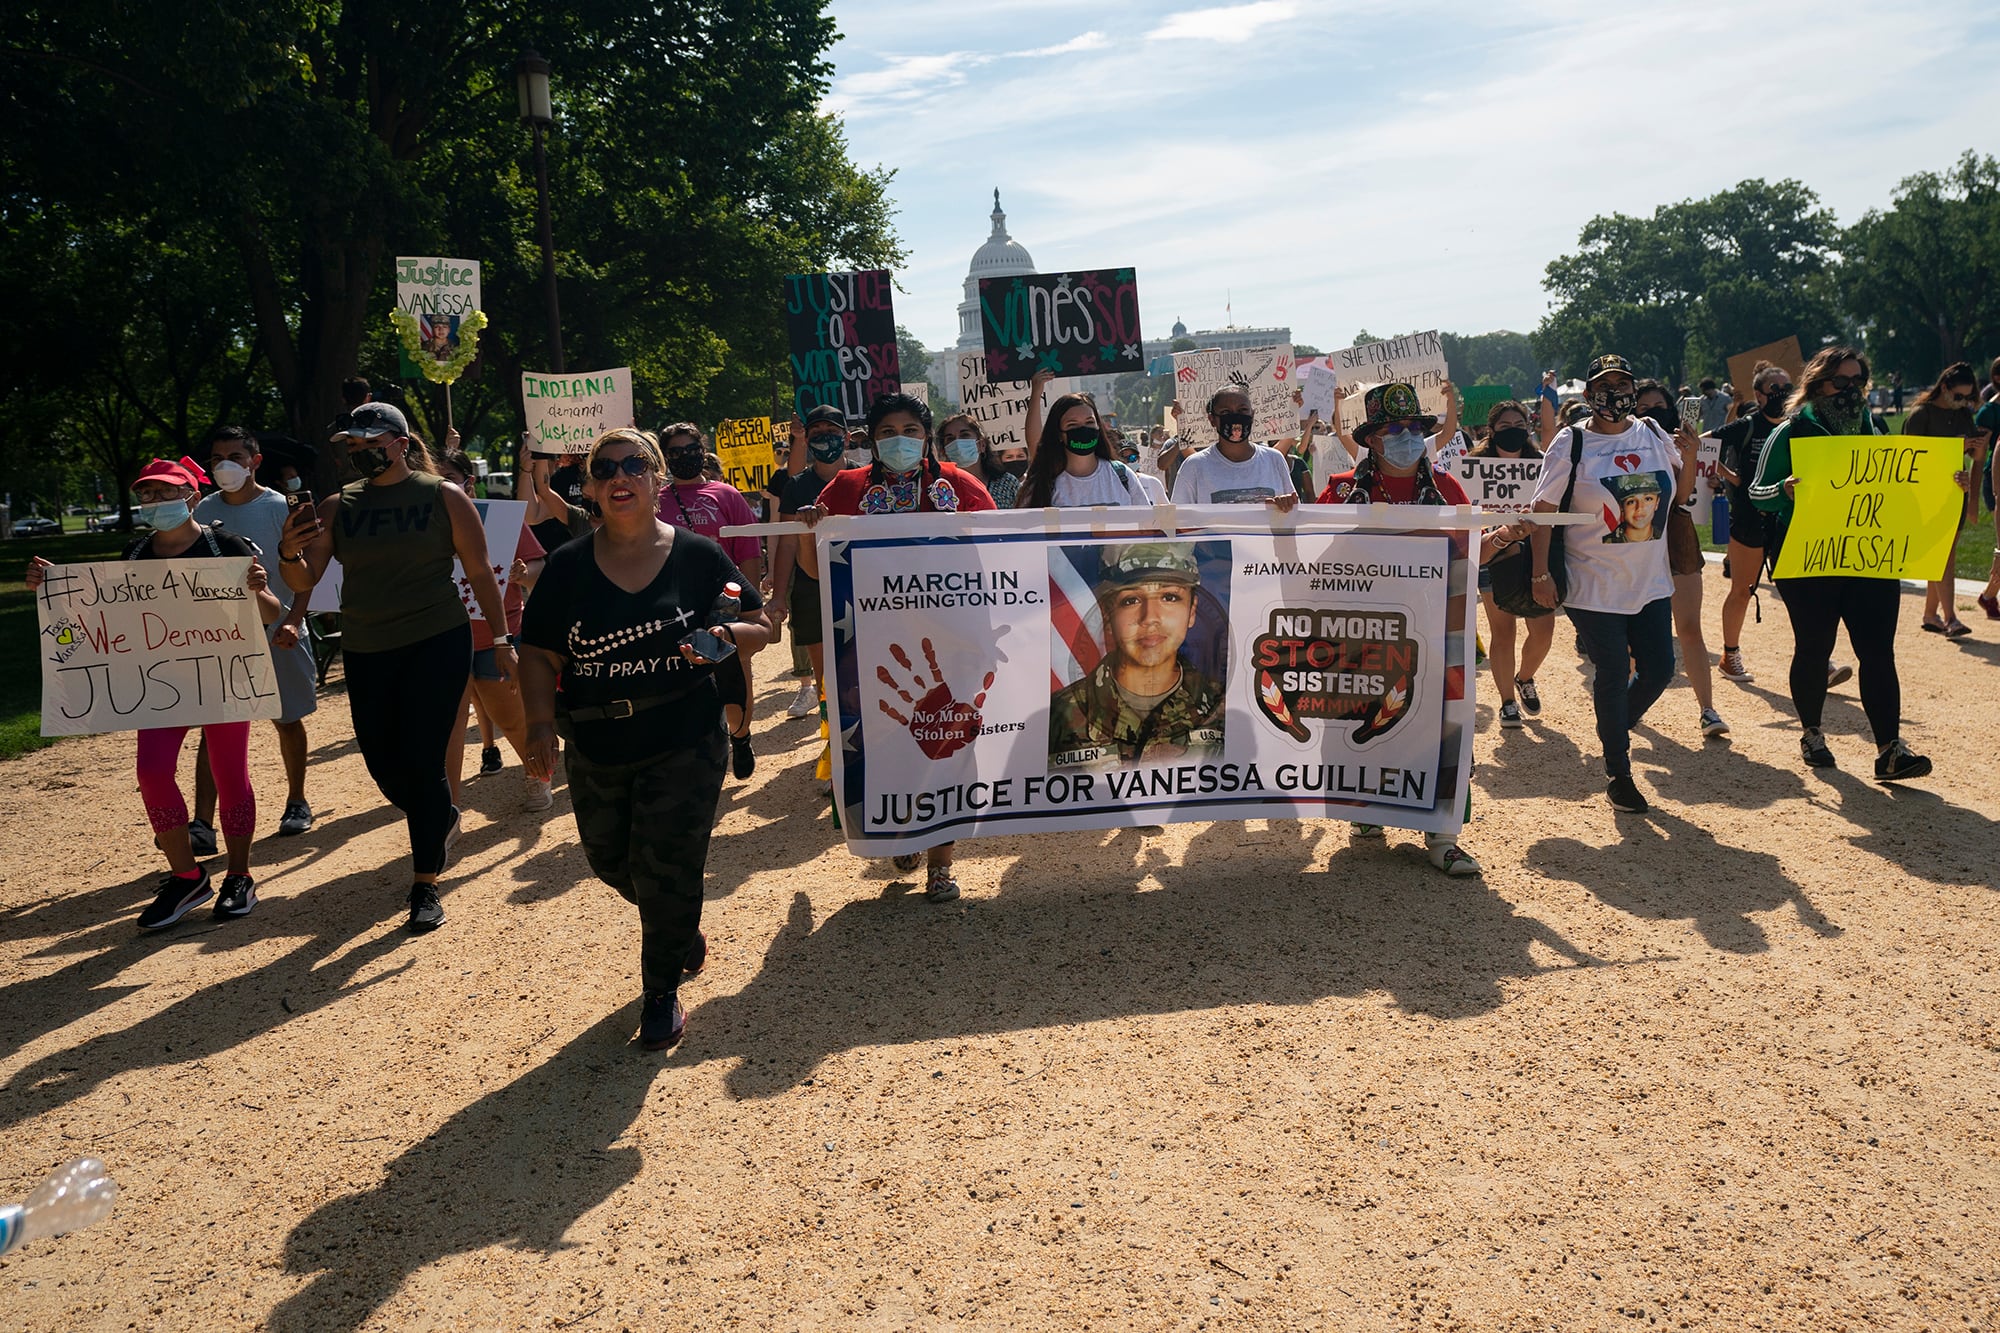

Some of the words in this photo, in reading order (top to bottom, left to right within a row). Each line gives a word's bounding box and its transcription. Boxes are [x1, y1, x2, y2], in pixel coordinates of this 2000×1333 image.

[397, 259, 474, 287] Justice
[398, 293, 475, 315] VANESSA
[785, 271, 891, 314] JUSTICE
[1341, 347, 1367, 369] SHE
[1368, 339, 1413, 364] FOUGHT
[1414, 330, 1442, 357] FOR
[1377, 363, 1394, 381] US
[1422, 369, 1443, 389] FOR
[524, 376, 616, 398] INDIANA
[720, 432, 770, 449] GUILLEN
[1830, 447, 1928, 489] JUSTICE
[1483, 480, 1521, 499] For
[341, 503, 433, 538] VFW
[1846, 492, 1884, 528] FOR
[1803, 535, 1909, 573] VANESSA!
[882, 572, 983, 594] MARCH
[992, 570, 1018, 590] IN
[1243, 562, 1444, 579] #IAMVANESSAGUILLEN
[40, 566, 158, 610] #Justice
[162, 570, 180, 599] 4
[181, 571, 246, 599] Vanessa
[1310, 578, 1374, 592] #MMIW
[858, 592, 997, 612] WASHINGTON
[1004, 590, 1044, 606] D.C.
[77, 610, 132, 654] We
[142, 612, 246, 650] Demand
[1275, 615, 1312, 638] NO
[1320, 616, 1400, 641] MORE
[49, 631, 87, 664] Vanessa
[1258, 639, 1412, 671] STOLEN
[609, 658, 661, 678] PRAY
[56, 653, 275, 719] JUSTICE
[1282, 671, 1386, 696] SISTERS
[914, 711, 935, 724] No
[939, 709, 982, 723] More
[1297, 697, 1371, 714] #MMIW
[914, 728, 966, 742] Stolen
[969, 721, 1026, 737] Sisters
[1056, 749, 1099, 766] GUILLEN
[871, 778, 1013, 825] JUSTICE
[1024, 774, 1095, 806] FOR
[1105, 763, 1265, 801] VANESSA
[1275, 763, 1427, 801] GUILLEN
